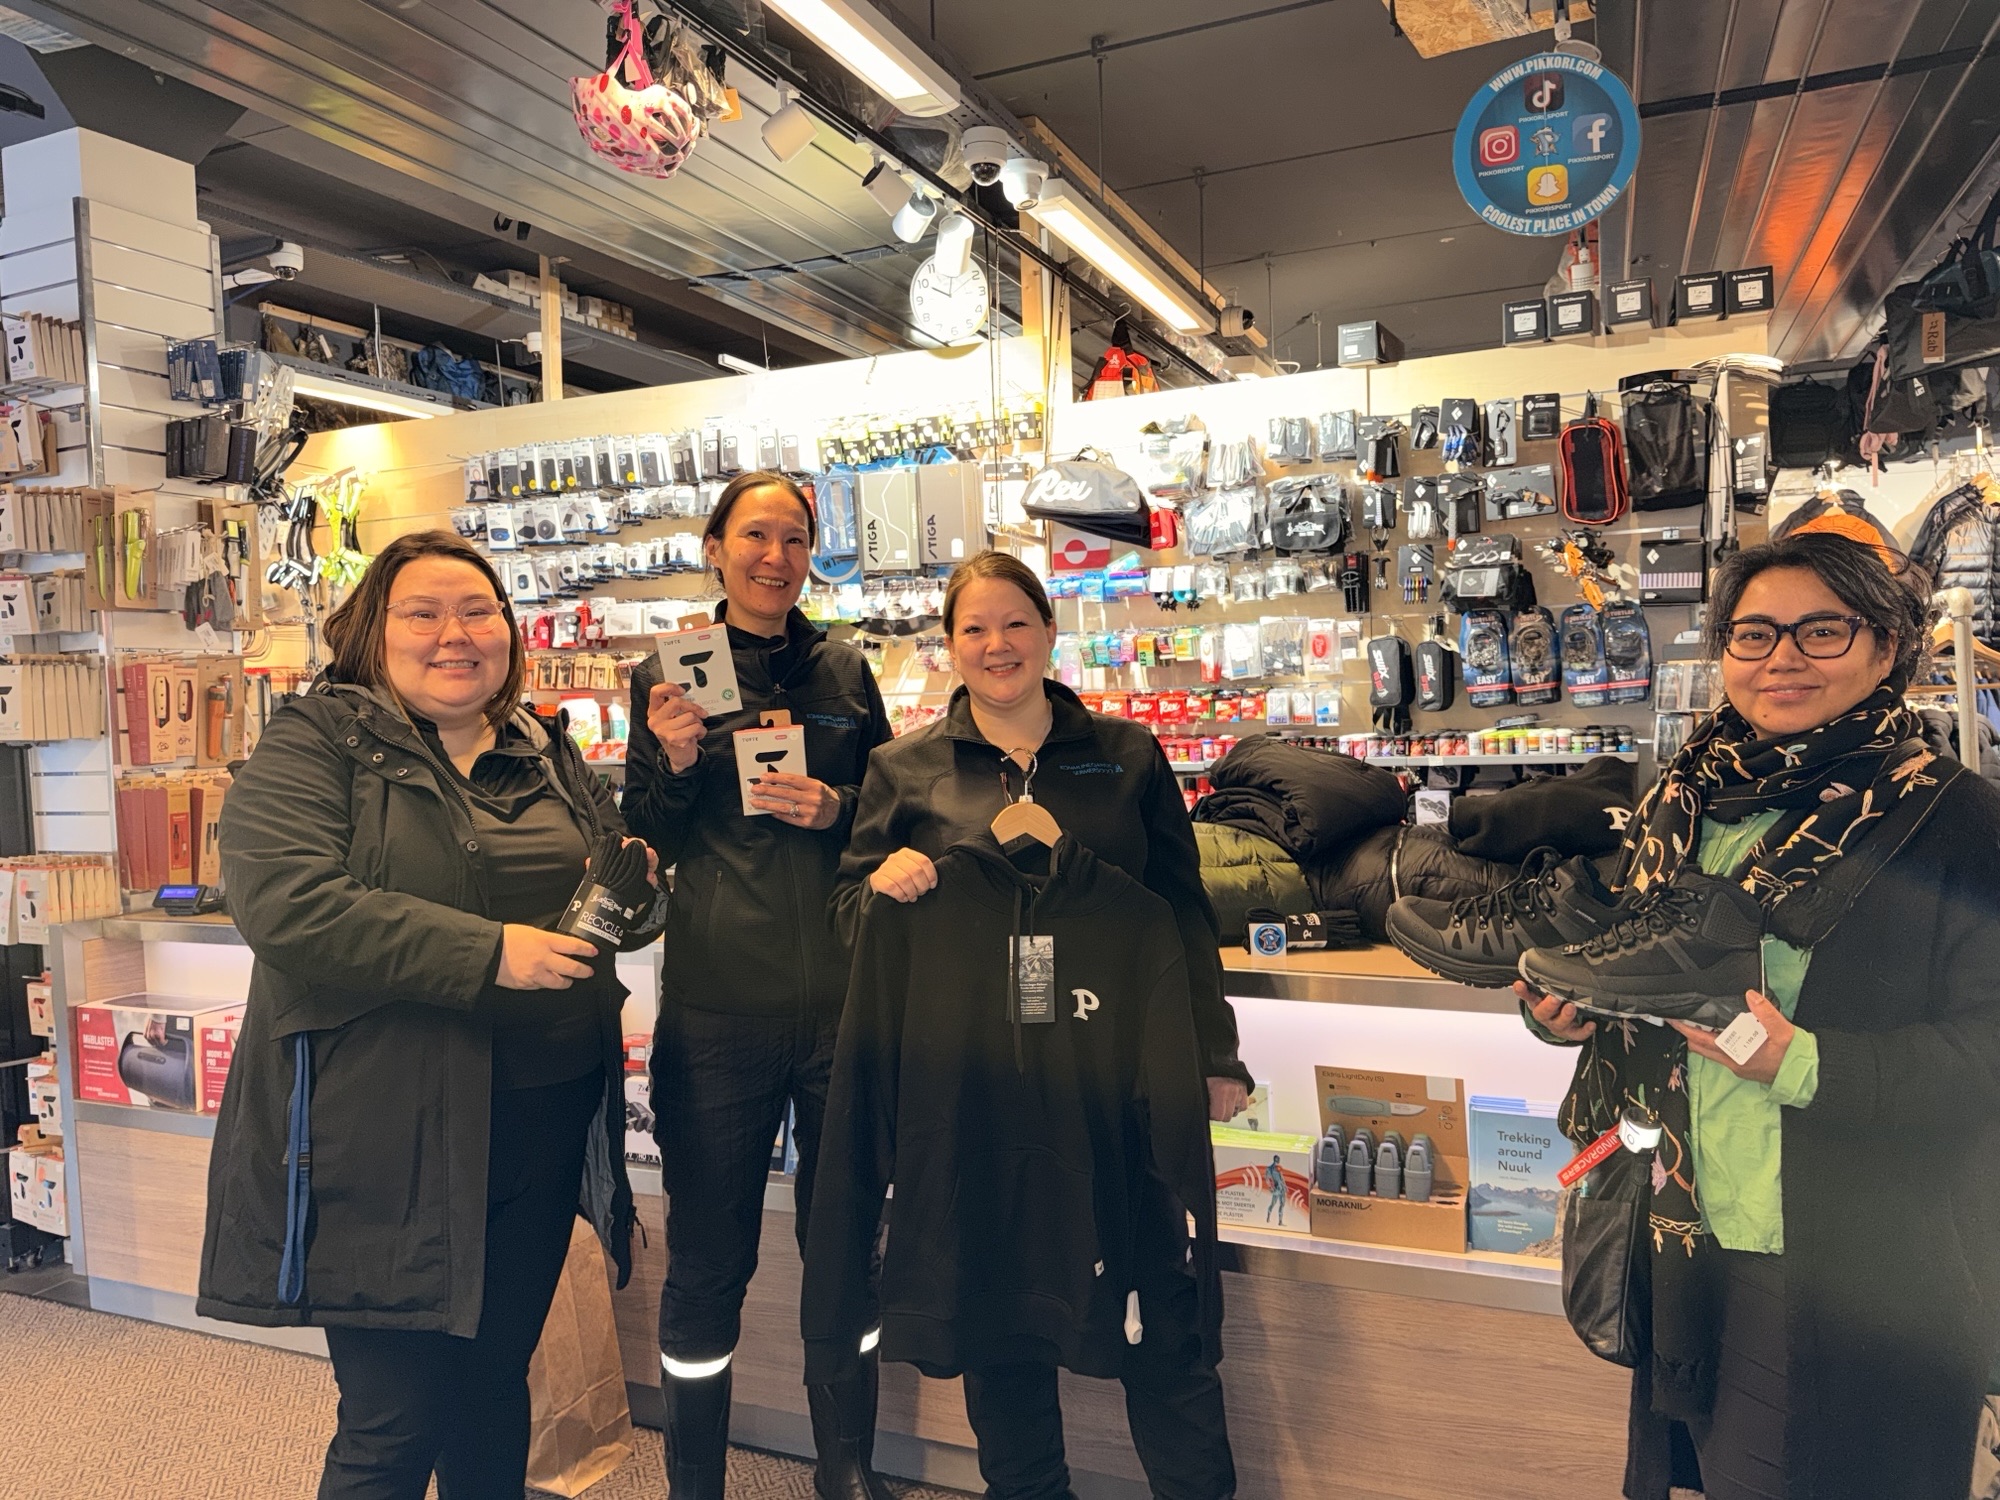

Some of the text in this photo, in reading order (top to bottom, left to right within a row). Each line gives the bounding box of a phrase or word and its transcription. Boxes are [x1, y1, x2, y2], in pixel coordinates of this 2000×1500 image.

[1489, 56, 1603, 92] WWW.PIKKORI.COM
[1567, 153, 1615, 164] PIKKORISPORT
[1478, 165, 1524, 178] PIKKORISPORT
[1482, 184, 1620, 233] COOLEST PLACE IN TOWN
[1525, 203, 1572, 215] PIKKORISPORT
[927, 263, 936, 274] 11
[971, 270, 980, 280] 2
[918, 278, 930, 289] 10
[978, 286, 986, 296] 3
[916, 296, 924, 306] 9
[1927, 331, 1939, 352] Rab
[867, 519, 878, 563] STIGA
[1477, 675, 1496, 684] EASY
[1525, 673, 1545, 684] EASY
[1576, 675, 1595, 684] EASY
[1615, 670, 1636, 681] EASY
[580, 911, 620, 936] RECYCLE
[1071, 988, 1100, 1021] P
[1497, 1130, 1551, 1148] Trekking
[1498, 1148, 1542, 1160] around
[1498, 1160, 1531, 1174] Nuuk
